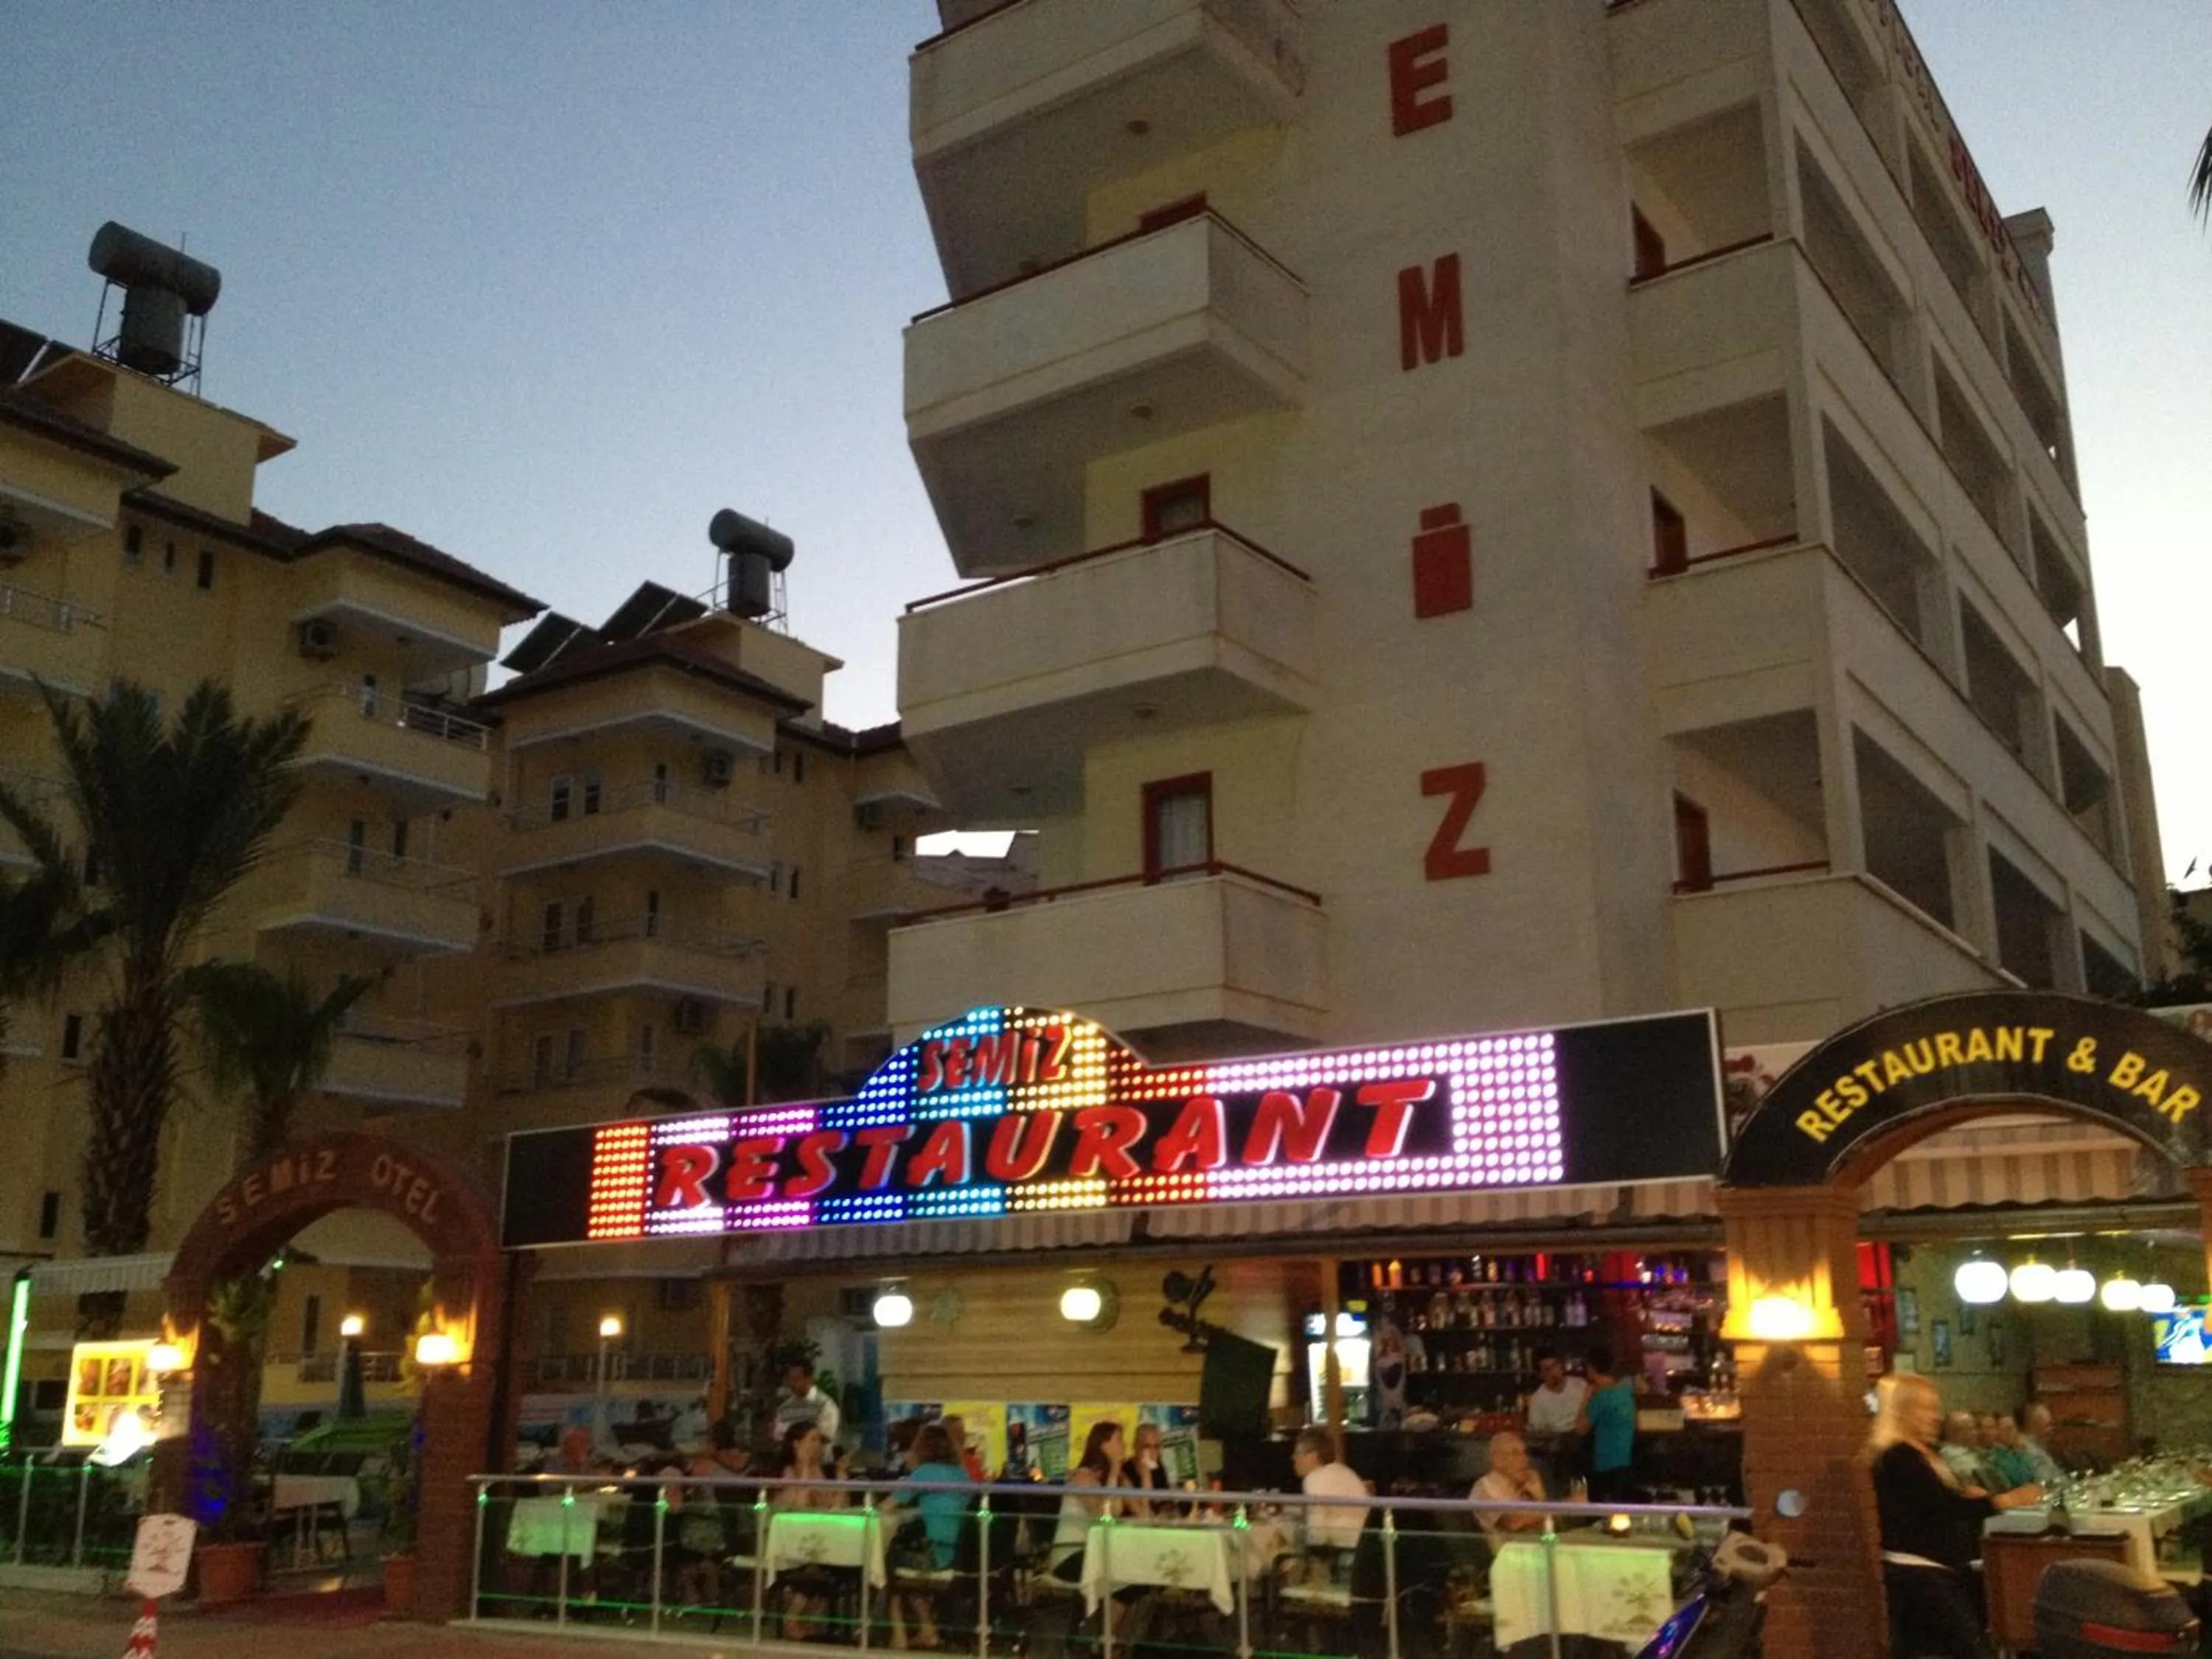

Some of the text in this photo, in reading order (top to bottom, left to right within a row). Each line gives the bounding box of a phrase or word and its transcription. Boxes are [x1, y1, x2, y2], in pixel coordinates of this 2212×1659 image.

[654, 1078, 1436, 1210] RESTAURANT
[1795, 1026, 2202, 1144] RESTAURANT & BAR
[372, 1153, 439, 1225] OTEL
